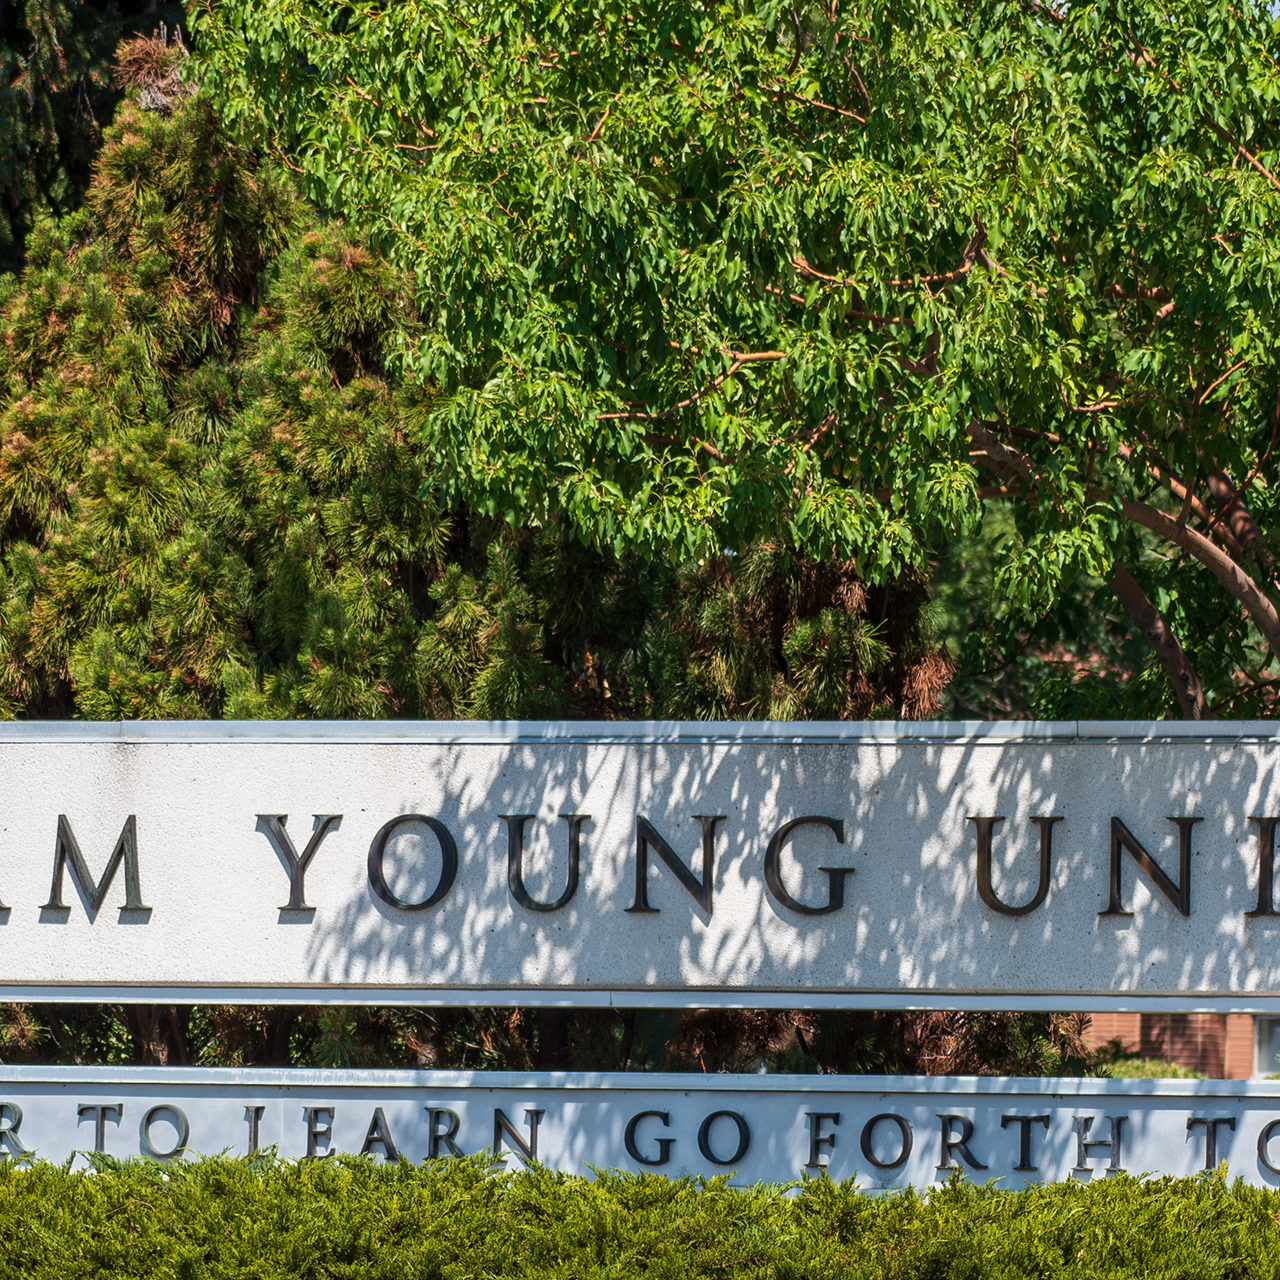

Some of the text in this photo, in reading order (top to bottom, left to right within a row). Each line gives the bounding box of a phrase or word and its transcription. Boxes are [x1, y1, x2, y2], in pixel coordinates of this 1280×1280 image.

[255, 813, 855, 917] YOUNG
[77, 1102, 190, 1157] TO
[243, 1105, 546, 1161] LEARN
[623, 1109, 751, 1167] GO
[804, 1111, 1129, 1171] FORTH
